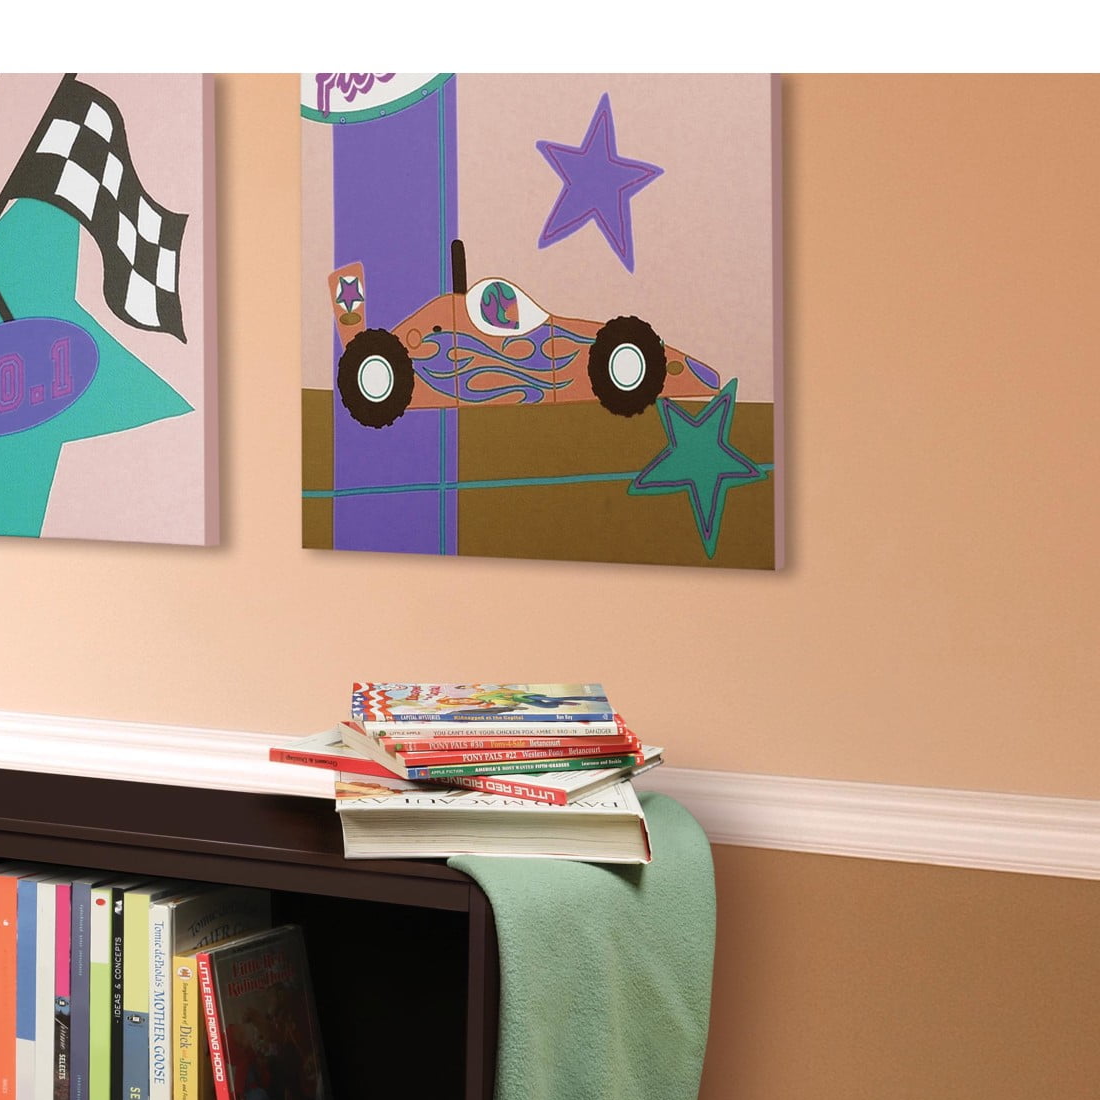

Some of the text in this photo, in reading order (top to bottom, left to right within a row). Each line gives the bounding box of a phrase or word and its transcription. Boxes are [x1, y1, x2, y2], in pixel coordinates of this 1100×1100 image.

[462, 753, 485, 762] PONY
[485, 753, 503, 761] PALS
[522, 749, 563, 758] Western Pony
[569, 747, 601, 755] Betancourt
[486, 778, 512, 793] RED
[514, 785, 556, 801] LITTLE
[154, 920, 165, 948] Tomie
[114, 936, 122, 980] CONCEPTS
[114, 994, 122, 1018] IDEAS
[153, 990, 166, 1043] MOTHER
[198, 961, 224, 1082] LITTLE RED RIDING HOOD
[179, 1025, 193, 1049] Dick
[58, 1053, 66, 1080] SELECTS
[153, 1045, 166, 1085] GOOSE
[179, 1057, 192, 1083] Jane
